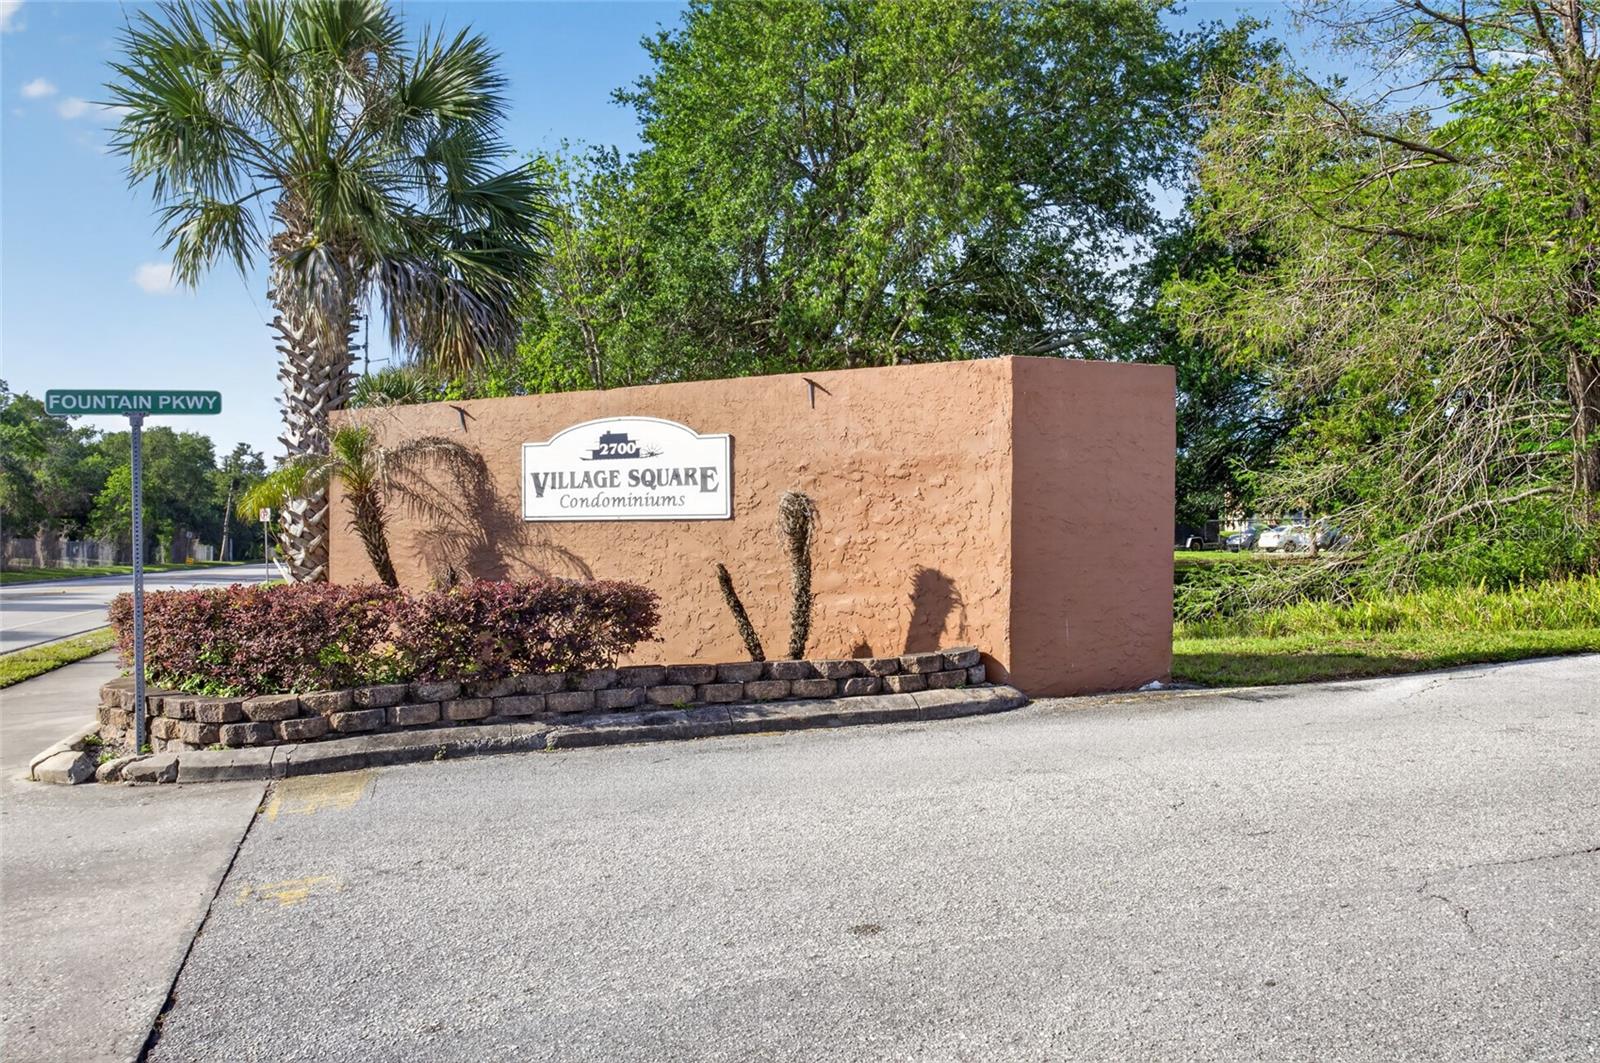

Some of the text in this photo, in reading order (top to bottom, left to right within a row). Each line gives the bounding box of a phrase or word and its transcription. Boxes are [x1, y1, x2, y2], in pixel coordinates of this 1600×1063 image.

[48, 395, 218, 410] FOUNTAIN PKWY
[599, 442, 637, 456] 2700
[530, 466, 719, 498] VILLAGE SQUARE
[559, 491, 685, 509] Condominiums
